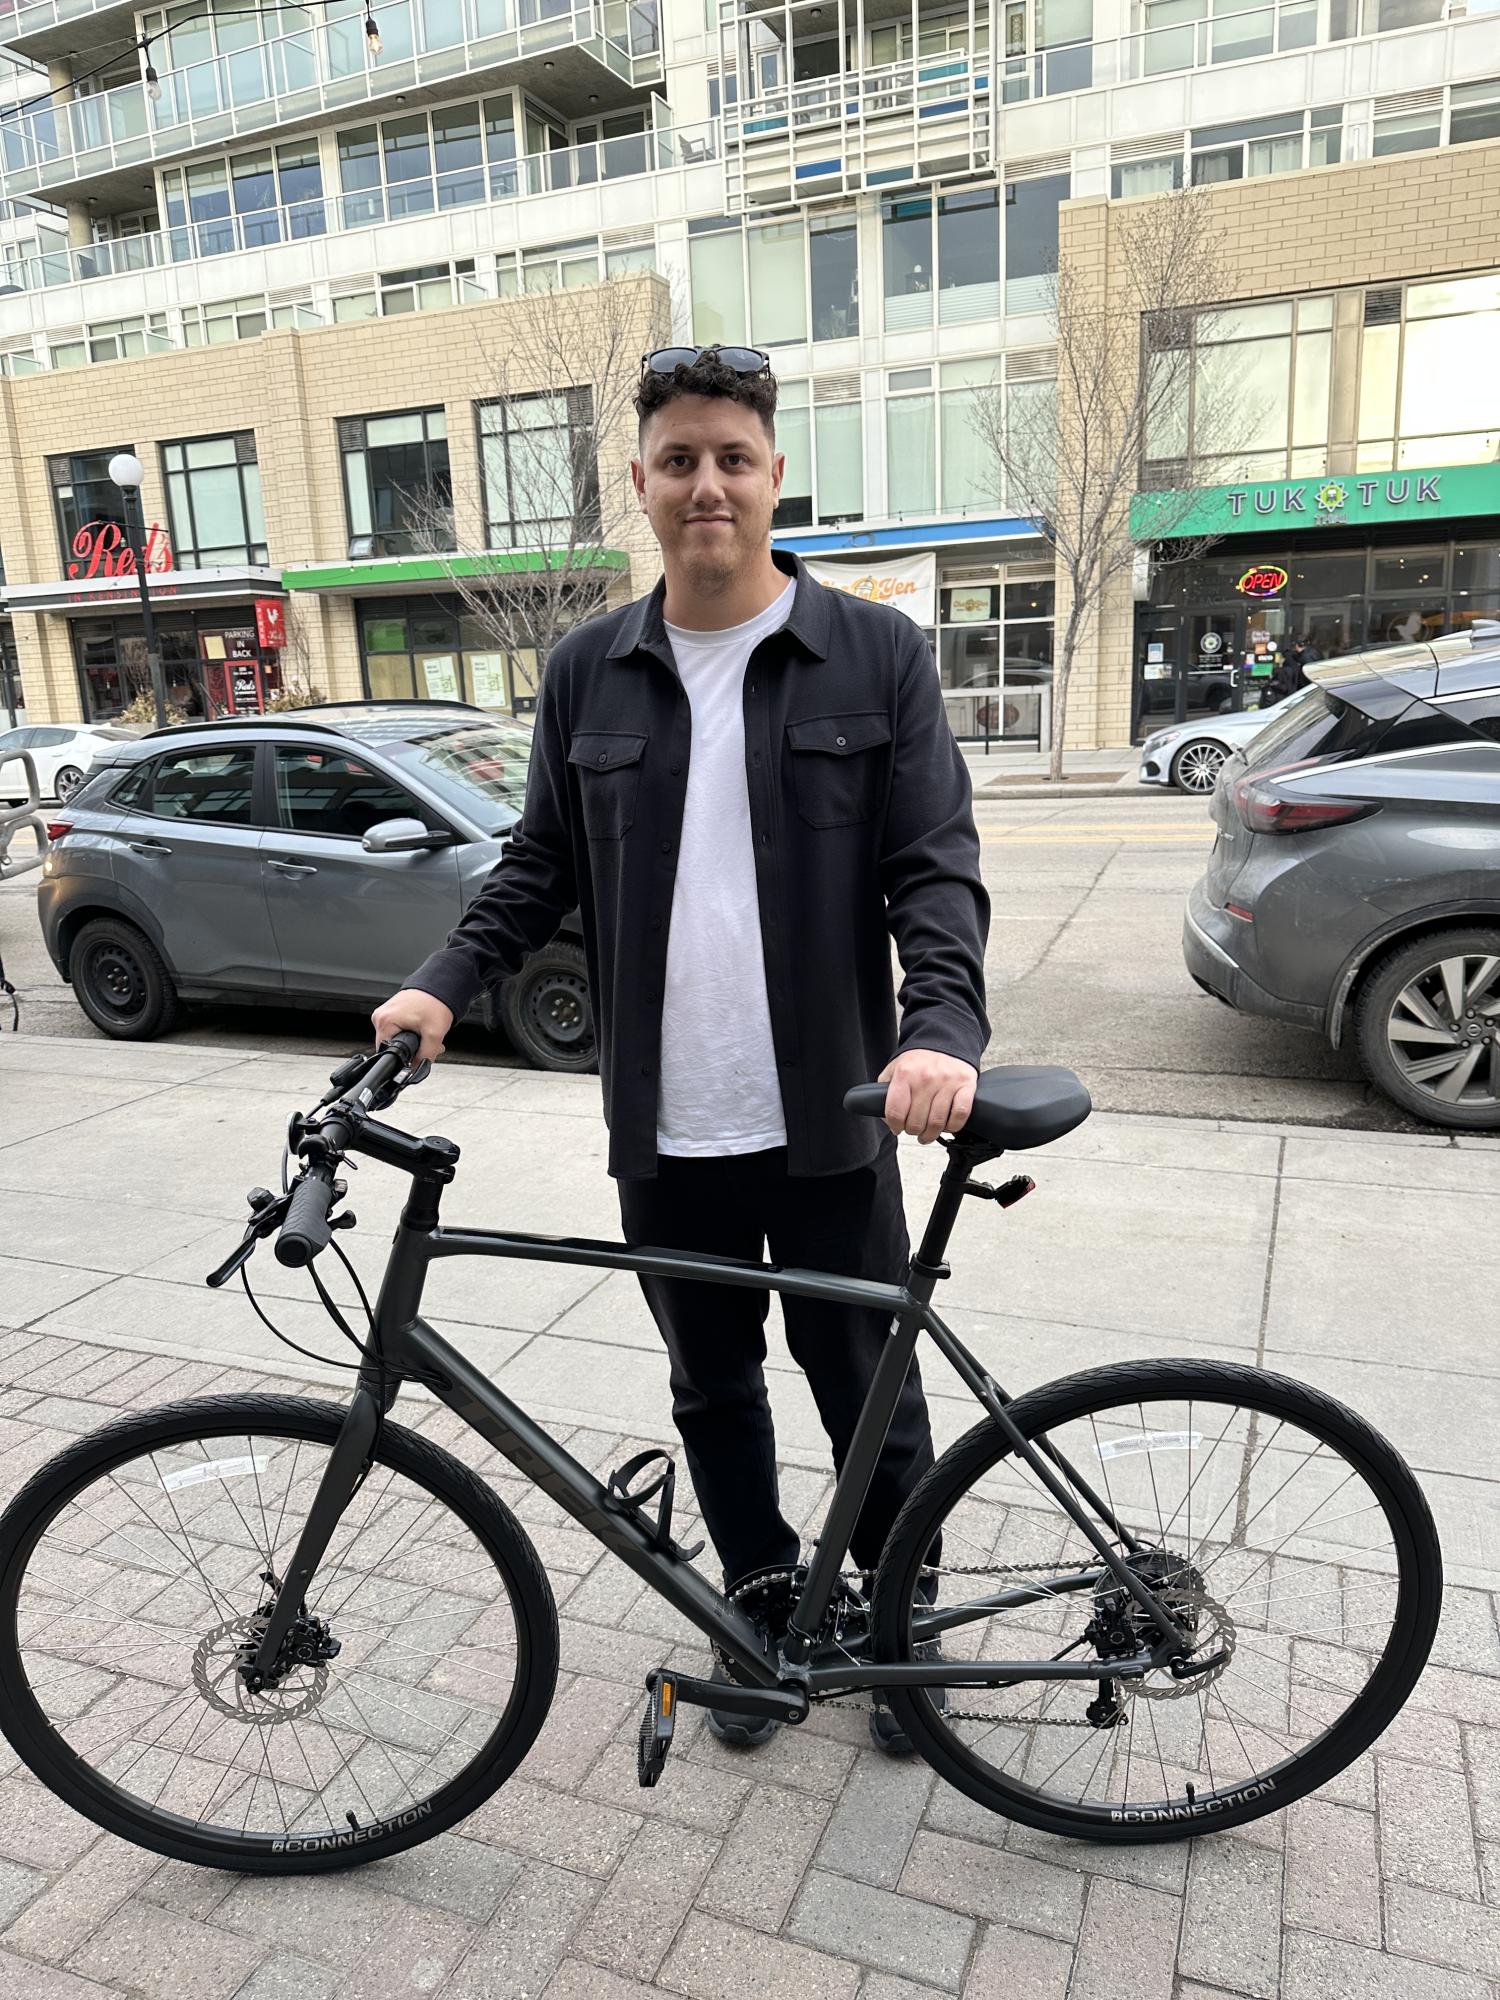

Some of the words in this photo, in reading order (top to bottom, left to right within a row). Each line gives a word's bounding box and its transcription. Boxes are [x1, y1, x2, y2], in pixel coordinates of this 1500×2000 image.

[1226, 486, 1307, 516] TUK
[1357, 474, 1442, 507] TUK
[1242, 572, 1285, 590] OPEN
[88, 585, 178, 602] KENSINTON
[224, 630, 255, 639] PARKING
[236, 640, 245, 648] IN
[231, 649, 252, 658] BACK
[1123, 1777, 1278, 1823] CONNECTION
[285, 1800, 434, 1853] CONNECTION
